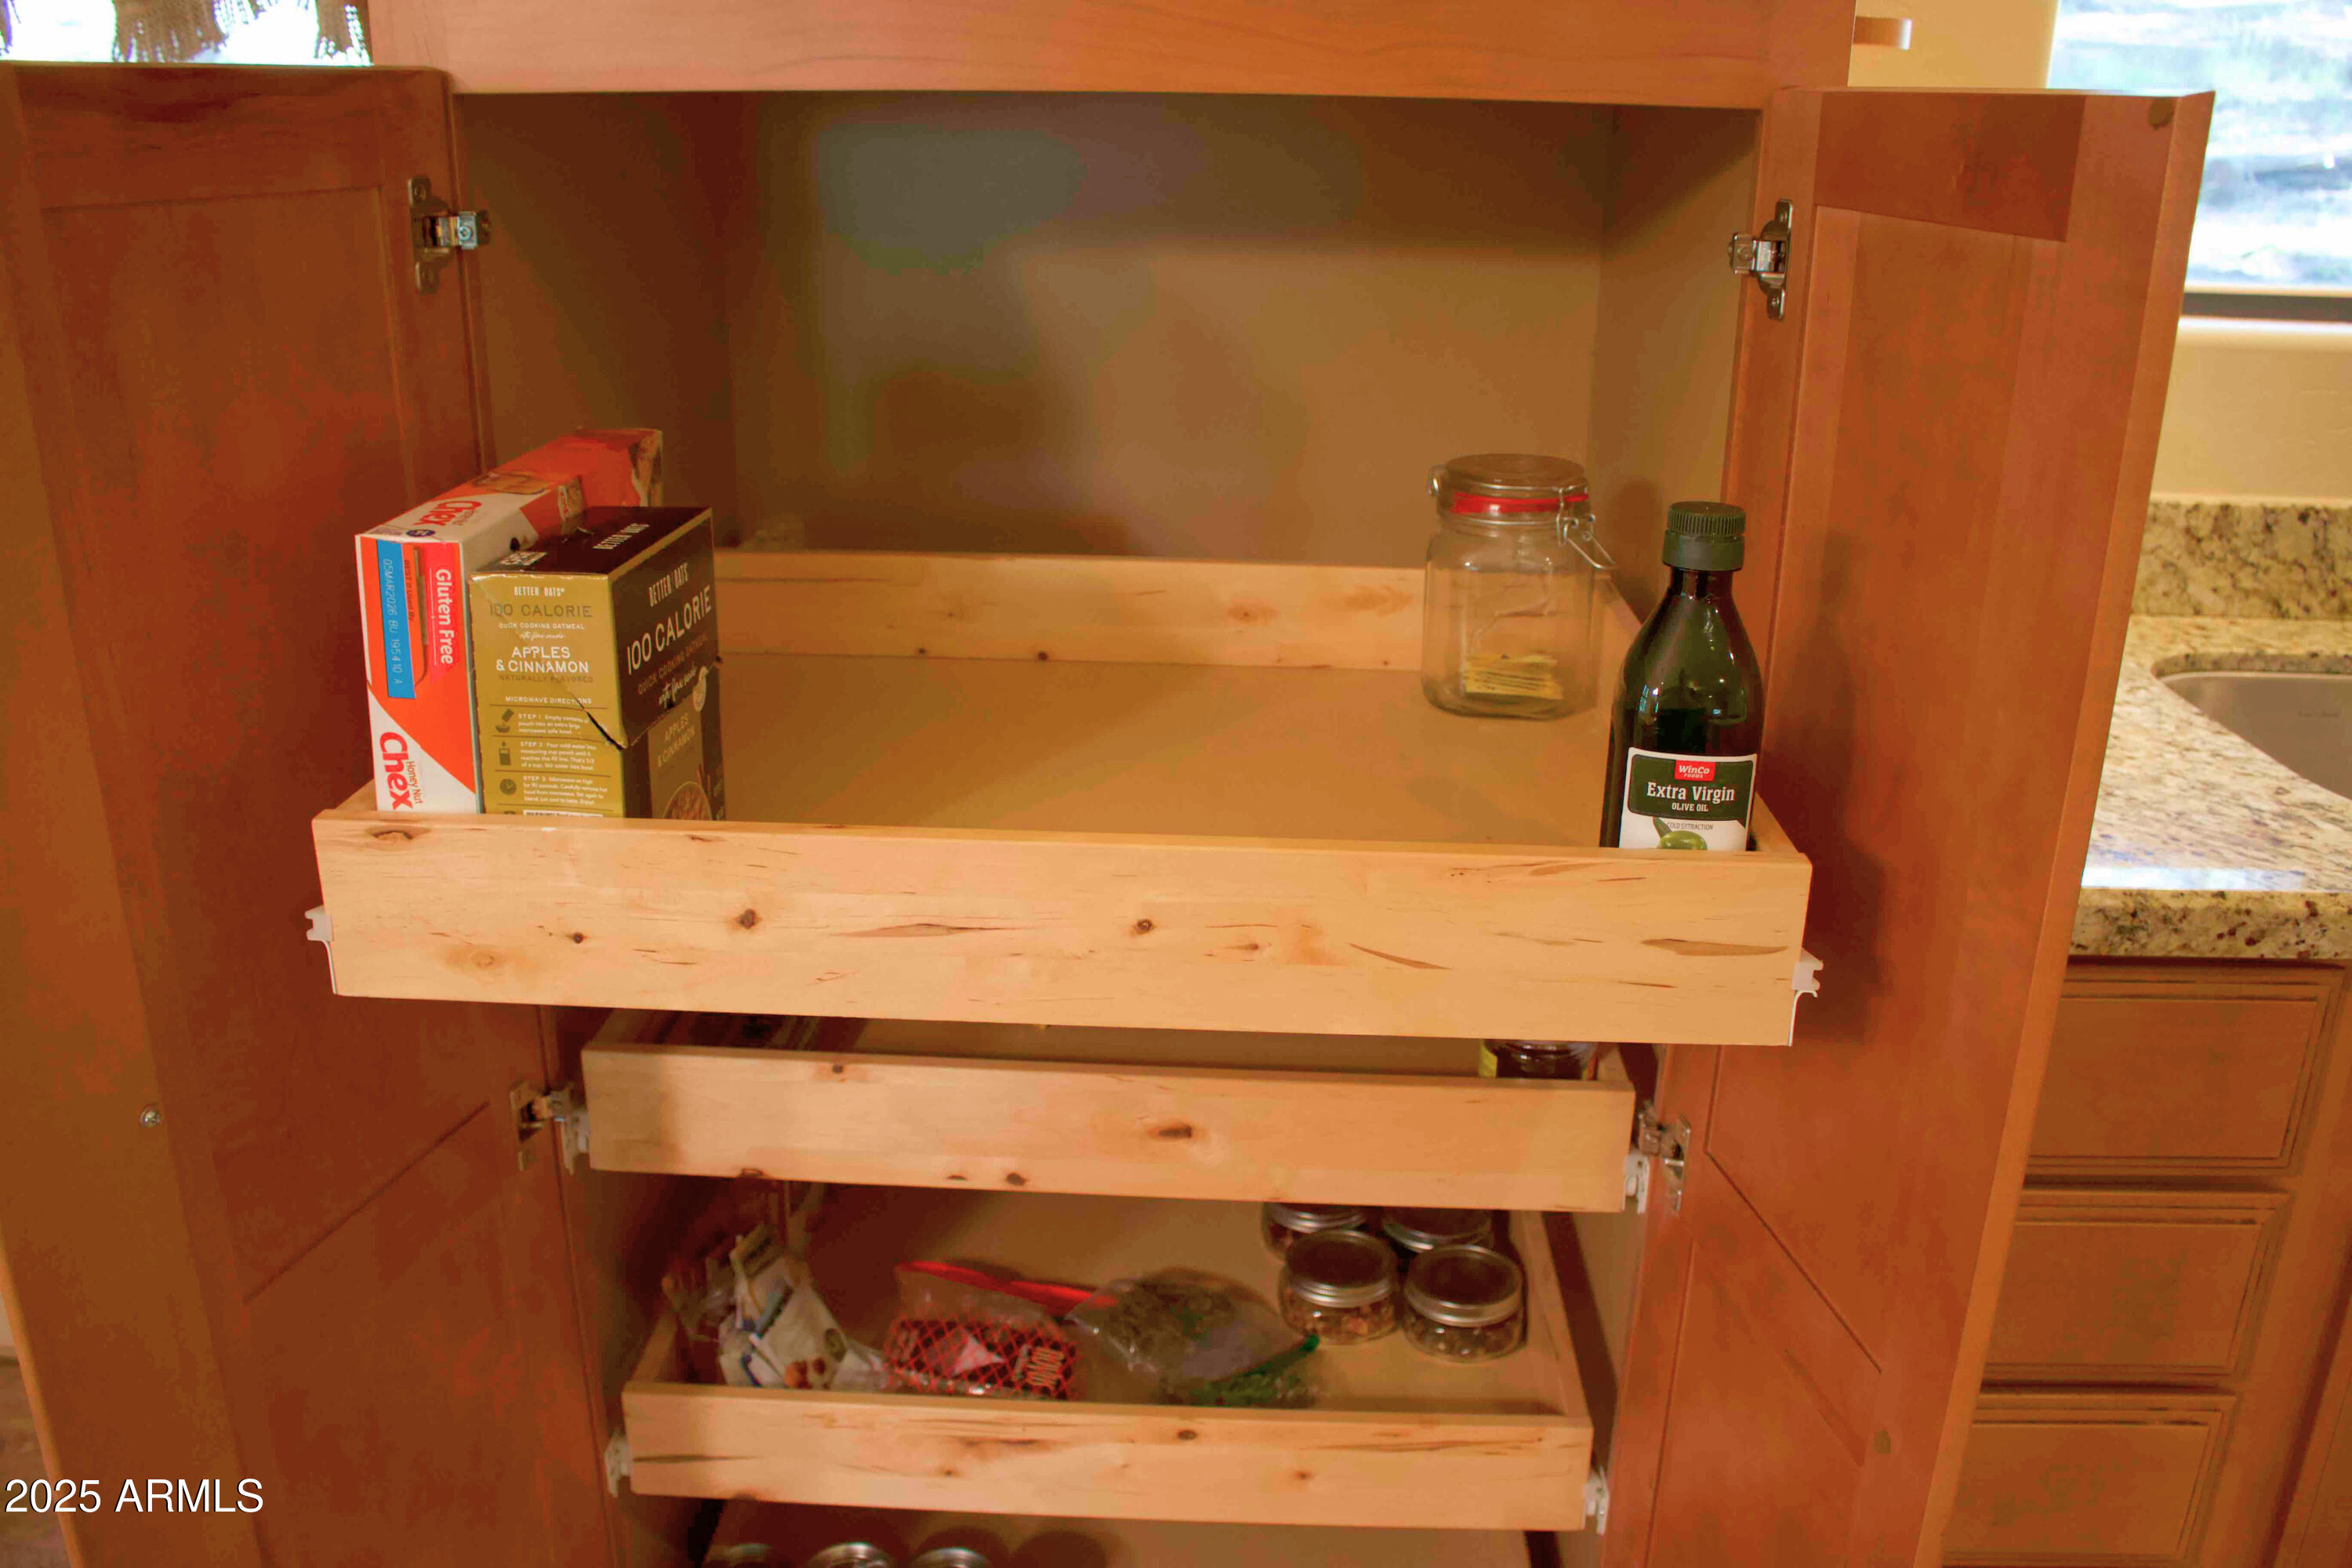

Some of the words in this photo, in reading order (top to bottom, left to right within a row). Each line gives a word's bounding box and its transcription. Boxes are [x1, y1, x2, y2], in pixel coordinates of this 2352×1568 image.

[412, 500, 482, 526] Chex
[436, 569, 452, 625] Gluten
[514, 586, 539, 597] BETTER
[649, 575, 671, 608] BETTER
[490, 604, 513, 617] 100
[521, 604, 593, 617] CALORIE
[627, 633, 652, 675] 100
[655, 585, 711, 652] CALORIE
[439, 630, 454, 664] Free
[511, 646, 571, 659] APPLES
[496, 659, 506, 671] &
[508, 660, 590, 673] CINNAMON
[379, 731, 413, 810] Chex
[406, 761, 419, 788] Honey
[1679, 764, 1710, 775] WinCo
[412, 789, 423, 804] Nut
[1647, 782, 1686, 800] Extra
[1692, 786, 1735, 804] Virgin
[1671, 802, 1693, 811] OLIVE
[1696, 803, 1708, 812] OIL
